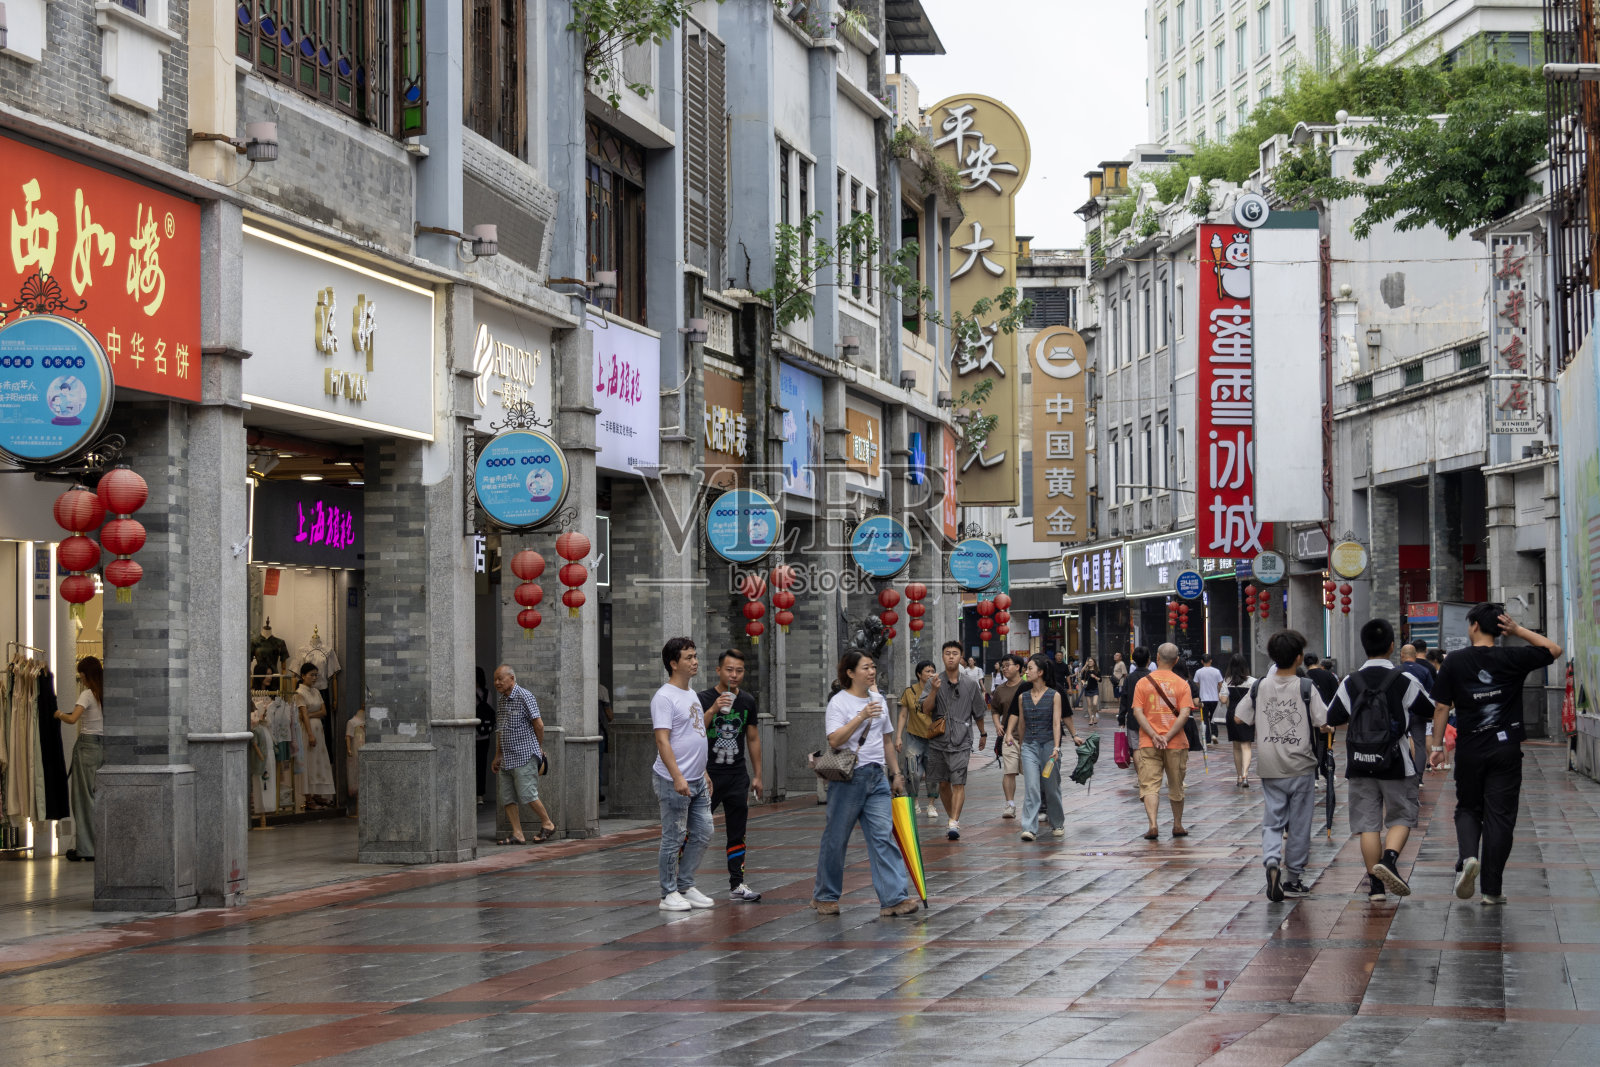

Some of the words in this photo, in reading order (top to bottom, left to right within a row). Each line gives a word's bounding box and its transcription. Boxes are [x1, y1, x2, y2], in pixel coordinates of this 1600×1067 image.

[106, 326, 190, 380] 中华名饼
[0, 380, 37, 391] 未成年人
[596, 352, 642, 406] 上海旗袍
[1045, 392, 1076, 536] 中国黄金
[294, 500, 355, 550] 上海旗袍
[1082, 548, 1123, 593] 中国黄金
[1354, 752, 1376, 762] PUMA
